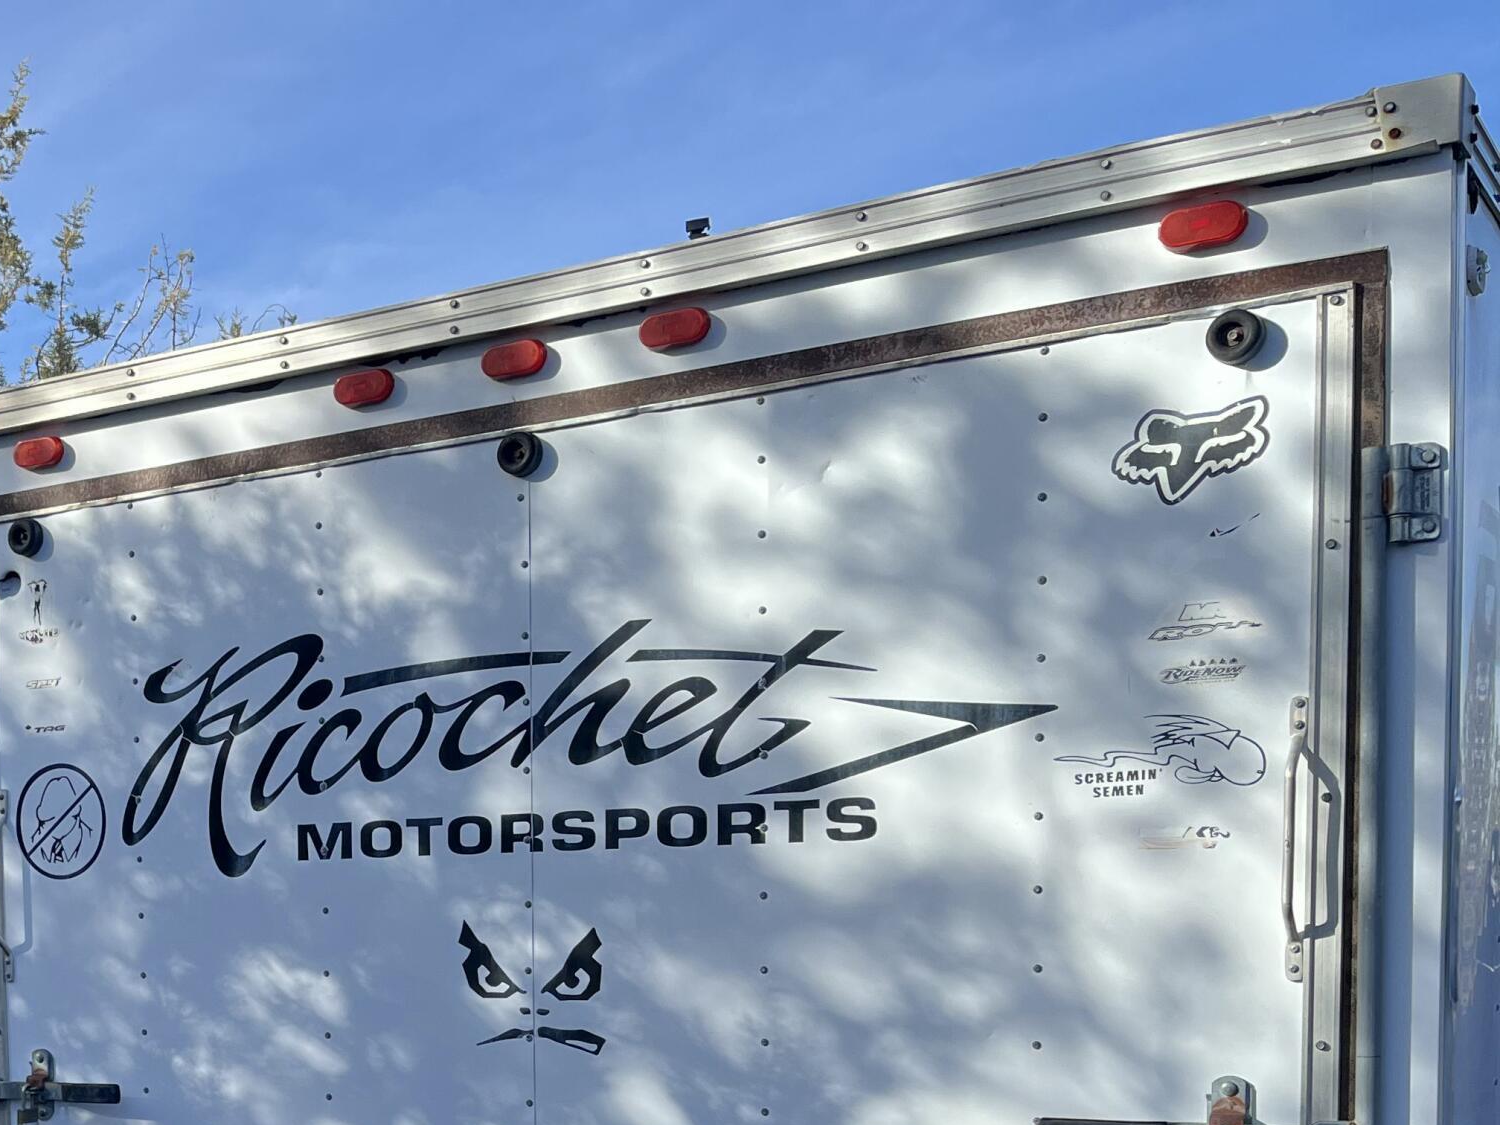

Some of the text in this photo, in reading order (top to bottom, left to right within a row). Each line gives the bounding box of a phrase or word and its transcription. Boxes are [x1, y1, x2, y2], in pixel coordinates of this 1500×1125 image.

[122, 619, 878, 878] Ricochet
[1093, 784, 1145, 798] SEMEN
[296, 796, 878, 862] MOTORSPORTS
